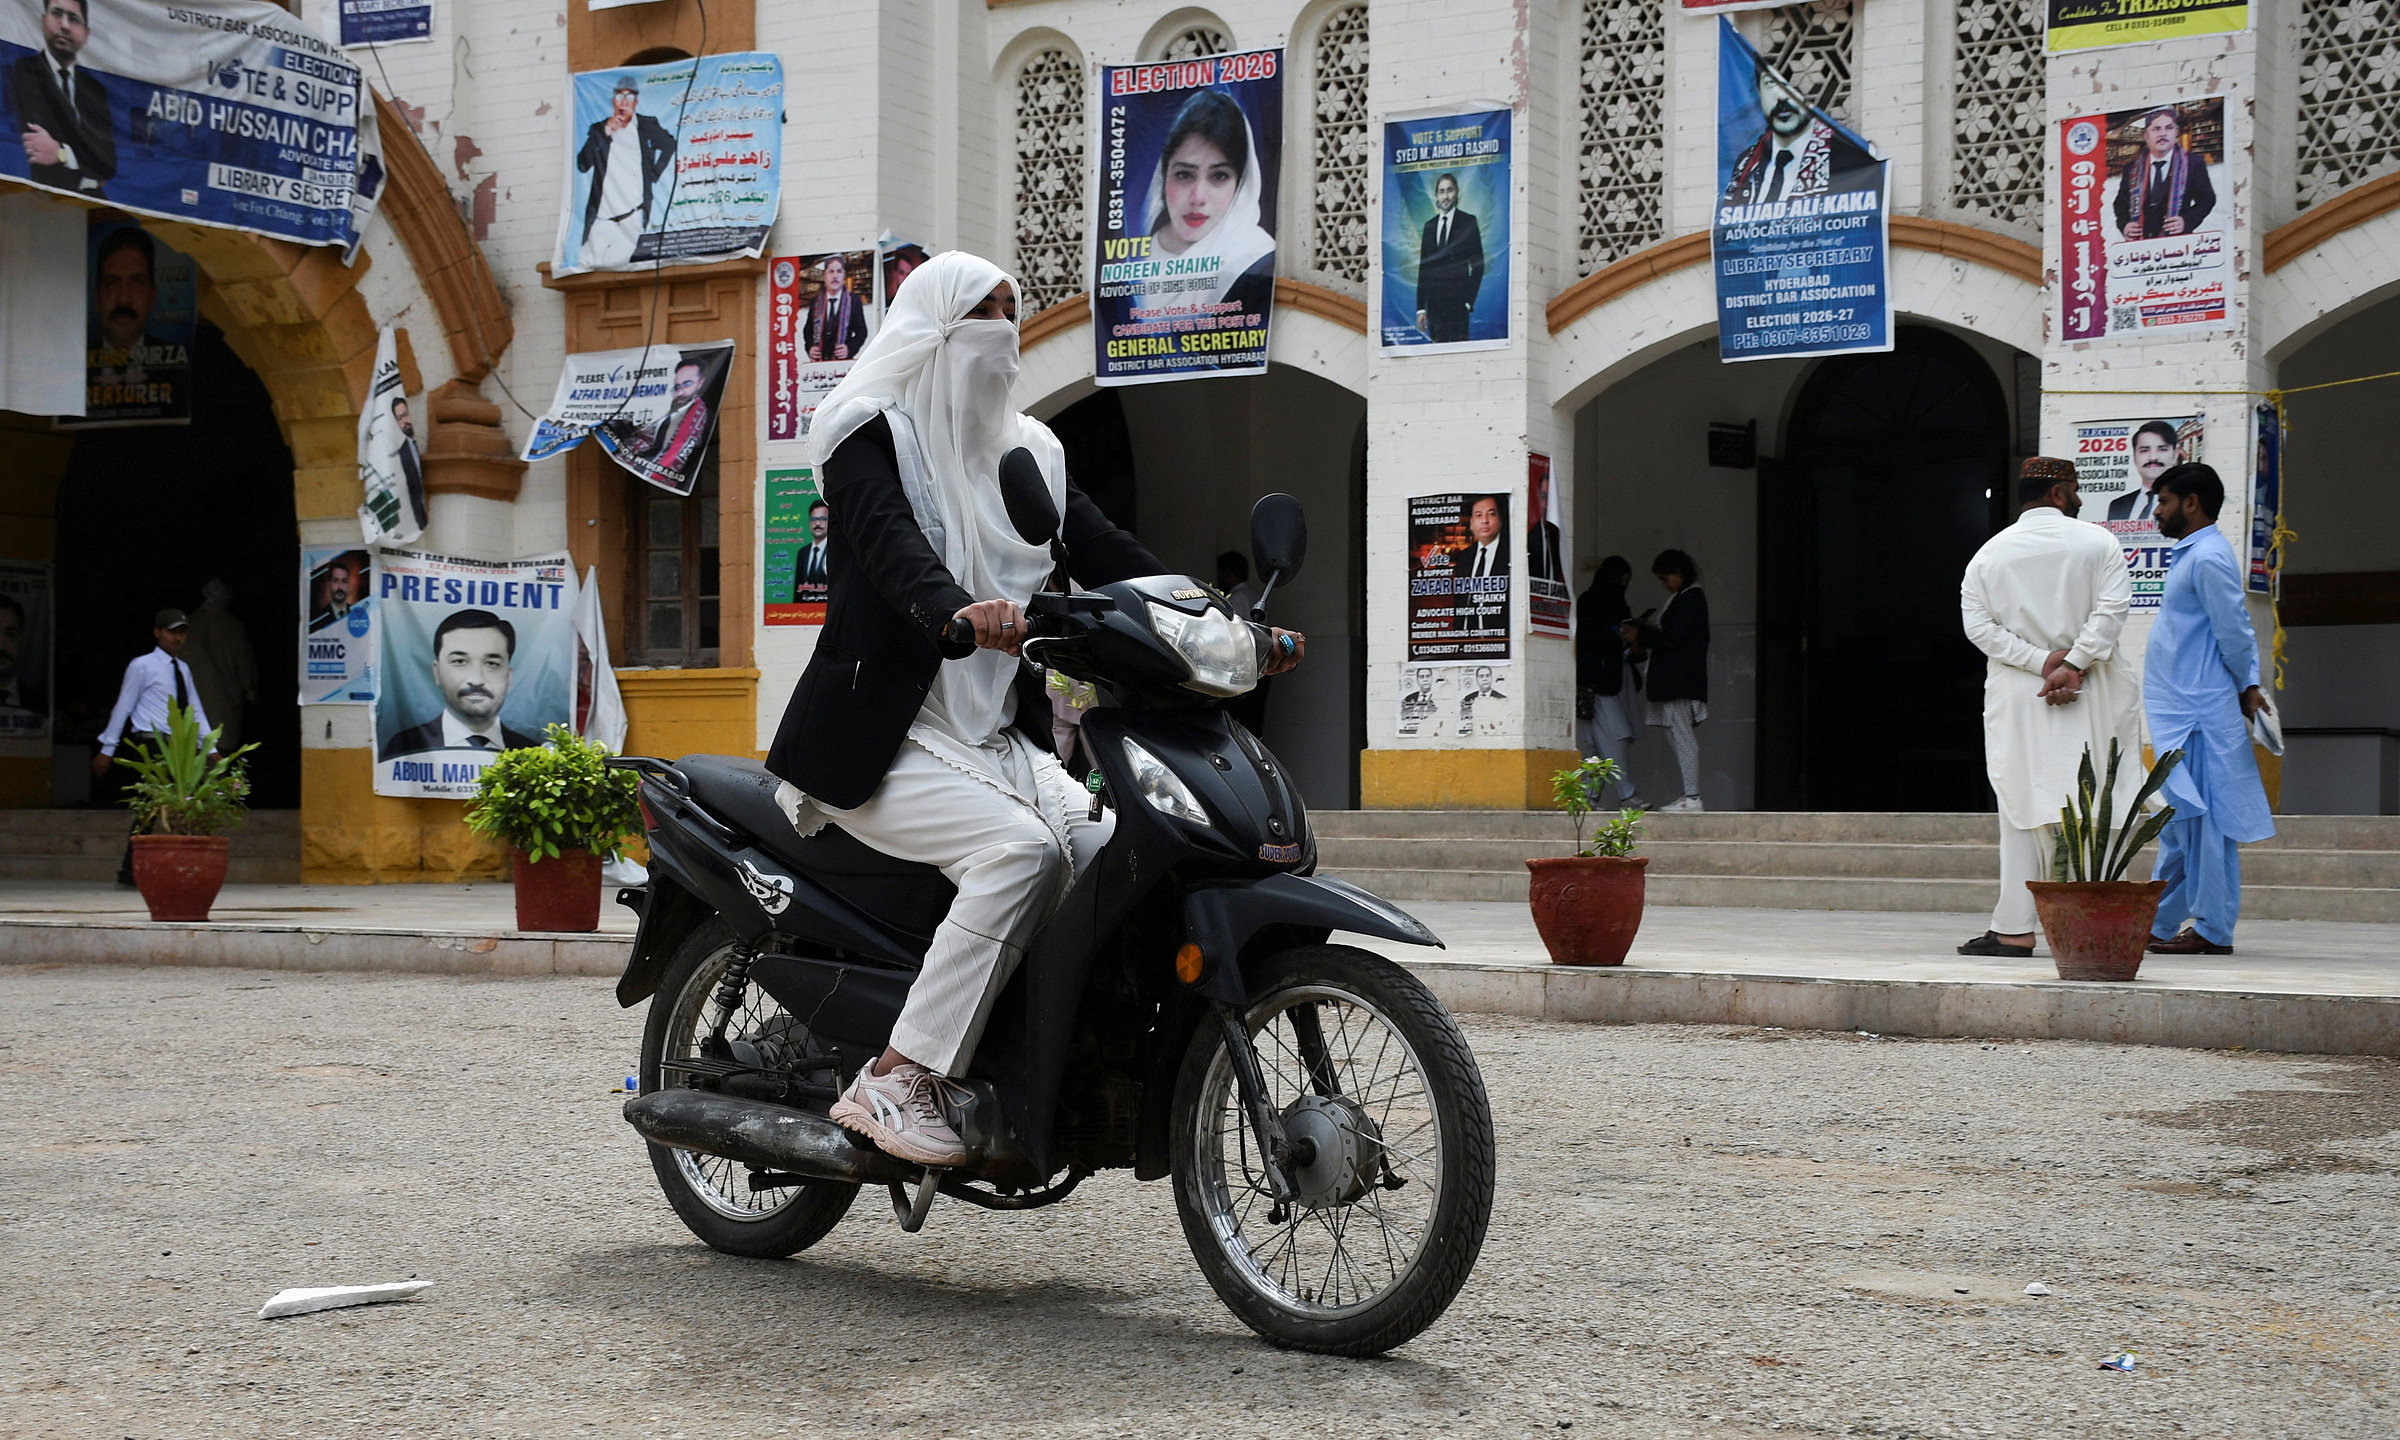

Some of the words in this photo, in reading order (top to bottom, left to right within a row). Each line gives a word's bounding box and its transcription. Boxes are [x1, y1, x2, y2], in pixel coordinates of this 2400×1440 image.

[167, 7, 222, 29] DISTRICT
[224, 14, 248, 36] BAR
[252, 24, 328, 55] ASSOCIATION
[284, 52, 351, 84] ELECTION
[1111, 59, 1214, 96] ELECTION
[1219, 51, 1276, 84] 2026
[273, 75, 286, 102] &
[147, 90, 202, 126] ABID
[209, 103, 308, 151] HUSSAIN
[1412, 131, 1433, 144] VOTE
[1445, 126, 1483, 142] SUPPORT
[1395, 148, 1418, 163] SYED
[1420, 146, 1431, 160] M.
[1432, 143, 1464, 159] AHMED
[1465, 139, 1499, 156] RASHID
[1108, 105, 1126, 229] 0331-3504472
[218, 167, 285, 197] LIBRARY
[1719, 201, 1787, 226] SAJJAD
[1788, 196, 1819, 218] ALI
[1822, 190, 1878, 215] KAKA
[1725, 223, 1789, 241] ADVOCATE
[1791, 220, 1822, 235] HIGH
[1825, 215, 1869, 231] COURT
[1104, 236, 1152, 260] VOTE
[1101, 261, 1161, 283] NOREEN
[1165, 255, 1221, 276] SHAIKH
[1723, 254, 1785, 275] LIBRARY
[1786, 246, 1874, 269] SECRETARY
[1100, 283, 1147, 299] ADVOCATE
[1149, 282, 1160, 295] OF
[1161, 279, 1185, 293] HIGH
[1187, 277, 1219, 291] COURT
[1765, 274, 1831, 291] HYDERABAD
[1726, 293, 1772, 309] DISTRICT
[1776, 291, 1797, 304] BAR
[1800, 284, 1876, 302] ASSOCIATION
[1130, 306, 1161, 320] Please
[1164, 305, 1187, 317] Vote
[1190, 303, 1199, 314] &
[1201, 300, 1242, 316] Support
[1746, 312, 1800, 329] ELECTION
[1803, 308, 1854, 324] 2026-27
[1112, 320, 1170, 337] CANDIDATE
[1173, 319, 1194, 332] FOR
[1196, 317, 1217, 331] THE
[1218, 315, 1245, 329] POST
[1246, 313, 1261, 327] OF
[1106, 335, 1176, 358] GENERAL
[1180, 329, 1267, 353] SECRETARY
[1733, 333, 1759, 350] PH:
[1761, 323, 1871, 347] 0307-3351023
[1108, 360, 1146, 372] DISTRICT
[1147, 358, 1165, 370] BAR
[1166, 354, 1219, 368] ASSOCIATION
[1221, 351, 1266, 364] HYDERABAD
[575, 373, 605, 384] PLEASE
[570, 388, 601, 400] AZFAR
[602, 386, 628, 400] BILAL
[2080, 427, 2129, 437] ELECTION
[2079, 438, 2127, 453] 2026
[634, 456, 687, 483] HYDERABAD
[2075, 456, 2111, 467] DISTRICT
[2113, 455, 2130, 465] BAR
[2077, 468, 2128, 480] ASSOCIATION
[2079, 482, 2126, 493] HYDERABAD
[1412, 496, 1446, 505] DISTRICT
[1447, 495, 1463, 503] BAR
[1411, 506, 1461, 516] ASSOCIATION
[1415, 516, 1460, 525] HYDERABAD
[2110, 520, 2154, 532] HUSSAIN
[380, 546, 422, 560] DISTRICT
[425, 553, 445, 563] BAR
[447, 556, 510, 569] ASSOCIATION
[511, 558, 565, 570] HYDERABAD
[429, 562, 487, 574] ELECTION
[2123, 547, 2172, 568] OTE
[1423, 568, 1454, 577] SUPPORT
[2129, 570, 2168, 579] PPORT
[381, 573, 564, 609] PRESIDENT
[1171, 590, 1204, 600] SUPER
[1411, 579, 1452, 596] ZAFAR
[1454, 575, 1509, 594] HAMEED
[1472, 593, 1506, 604] SHAIKH
[2131, 597, 2161, 605] 0337
[1416, 607, 1455, 618] ADVOCATE
[1455, 607, 1475, 616] HIGH
[1476, 606, 1502, 616] COURT
[1470, 628, 1506, 637] COMMITTEE
[309, 644, 346, 659] MMC
[392, 761, 437, 783] ABDUL
[1259, 843, 1284, 862] SUPER
